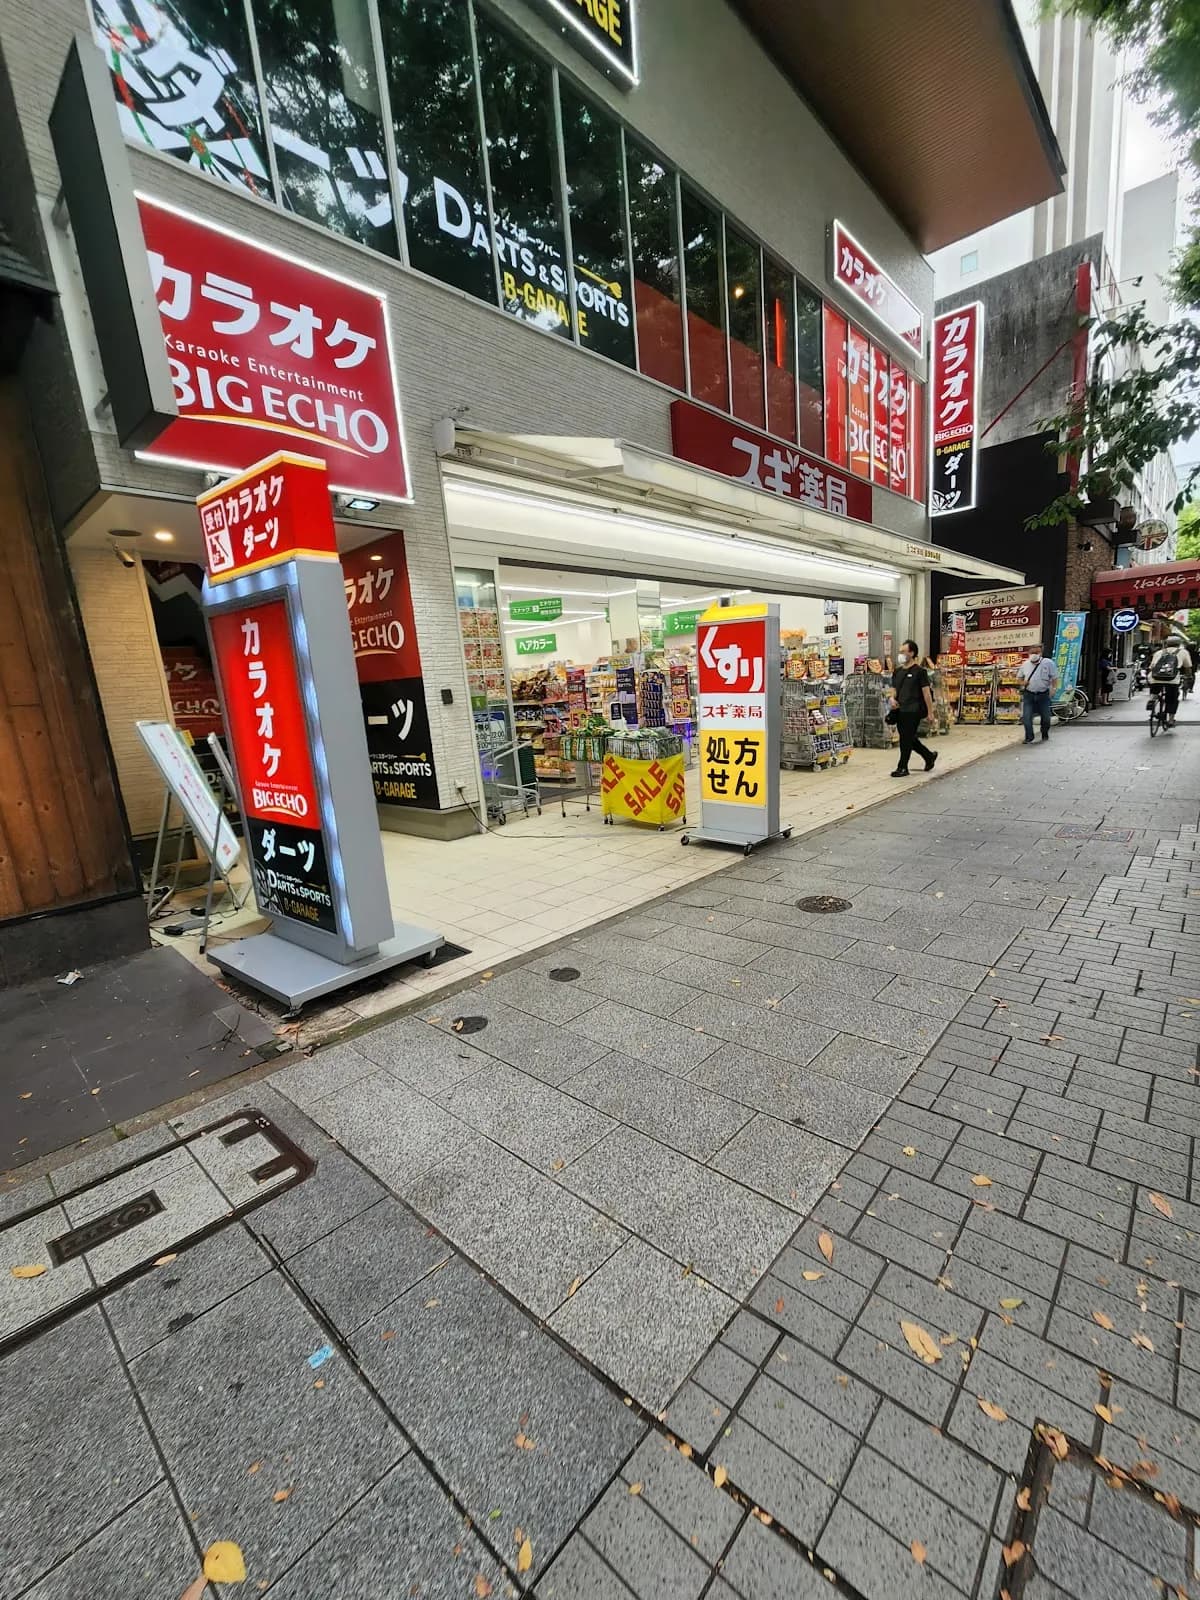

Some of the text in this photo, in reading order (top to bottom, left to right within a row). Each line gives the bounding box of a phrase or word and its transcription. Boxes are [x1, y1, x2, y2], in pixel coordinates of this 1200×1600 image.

[841, 247, 887, 306] カラオケ
[146, 250, 377, 369] カラオケ
[503, 271, 589, 337] B-GARAE
[164, 333, 365, 402] Karaoke Entertainment
[940, 316, 971, 427] カラオケ
[168, 357, 389, 454] BIG ECHO
[935, 430, 950, 443] BIG
[951, 423, 974, 437] ECHO
[226, 475, 284, 527] カラオケ
[731, 436, 848, 516] スギ薬局
[944, 452, 962, 508] ダーツ
[243, 517, 279, 558] ダーツ
[991, 605, 1030, 617] カラオケ
[1006, 616, 1029, 625] ECHO
[519, 638, 553, 651] ヘアカラー
[700, 626, 763, 692] くすり
[241, 617, 282, 778] カラオケ
[702, 703, 762, 719] スギ薬局
[706, 735, 760, 766] 処方
[252, 787, 308, 817] BIG ECHO
[374, 781, 418, 799] B-GARAGE
[623, 761, 667, 817] SALE
[707, 768, 758, 798] せん
[261, 827, 316, 873] ダーツ
